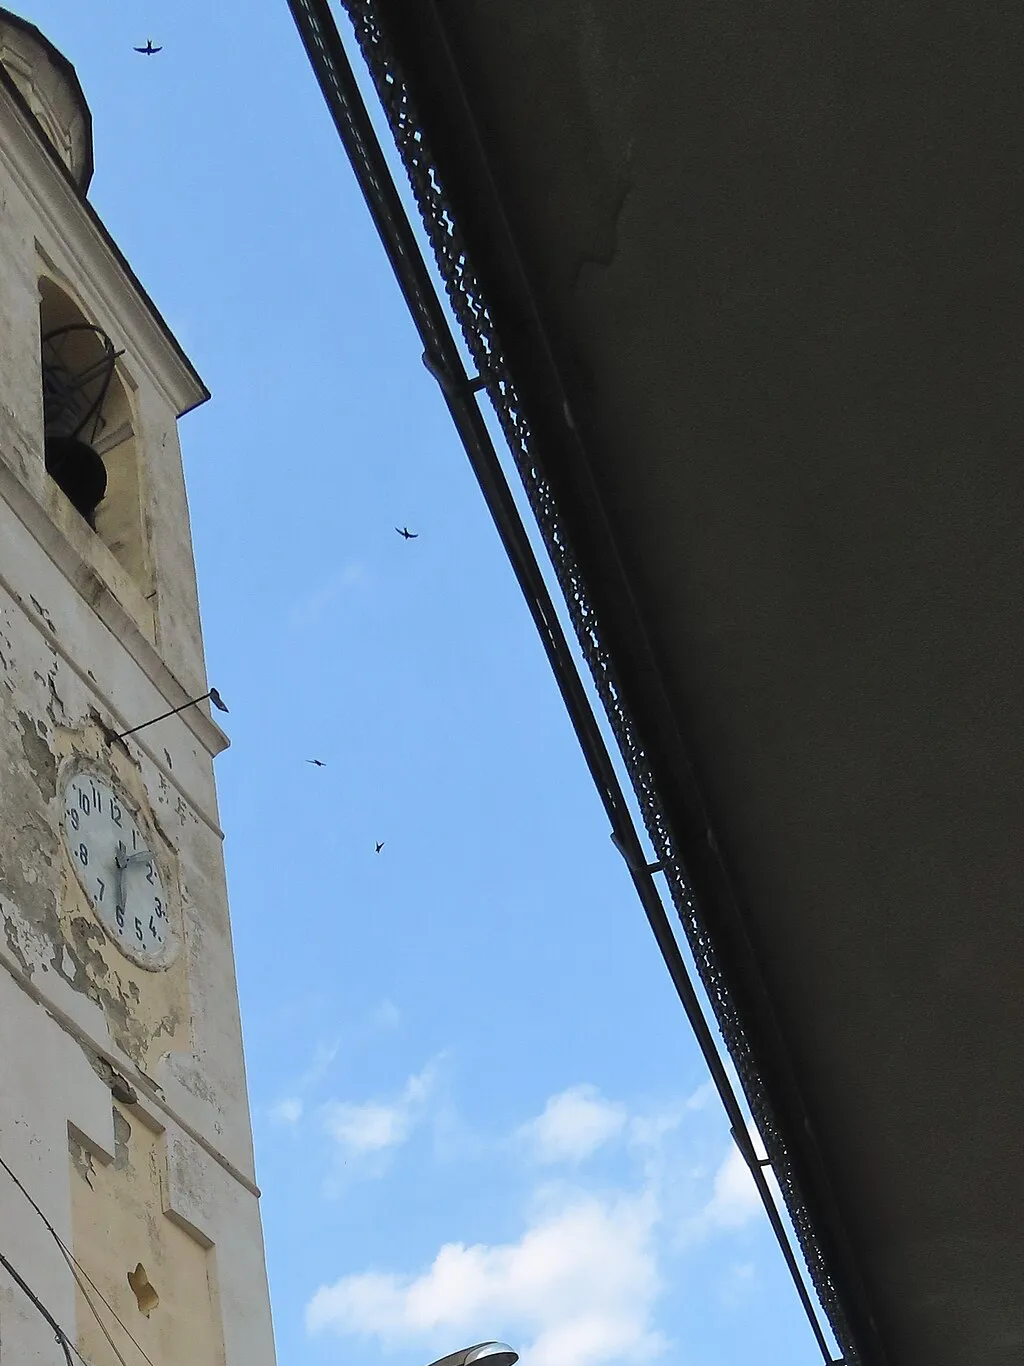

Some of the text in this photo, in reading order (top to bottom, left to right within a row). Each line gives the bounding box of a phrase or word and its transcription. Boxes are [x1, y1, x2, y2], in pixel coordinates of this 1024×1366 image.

[78, 788, 90, 815] 10
[91, 786, 101, 812] 11
[70, 808, 80, 831] 9
[110, 799, 122, 828] 12
[79, 843, 88, 866] 8
[146, 864, 155, 885] 2
[96, 877, 105, 901] 7
[115, 905, 124, 927] 6
[155, 897, 163, 918] 3
[135, 917, 143, 940] 5
[149, 916, 158, 938] 4
